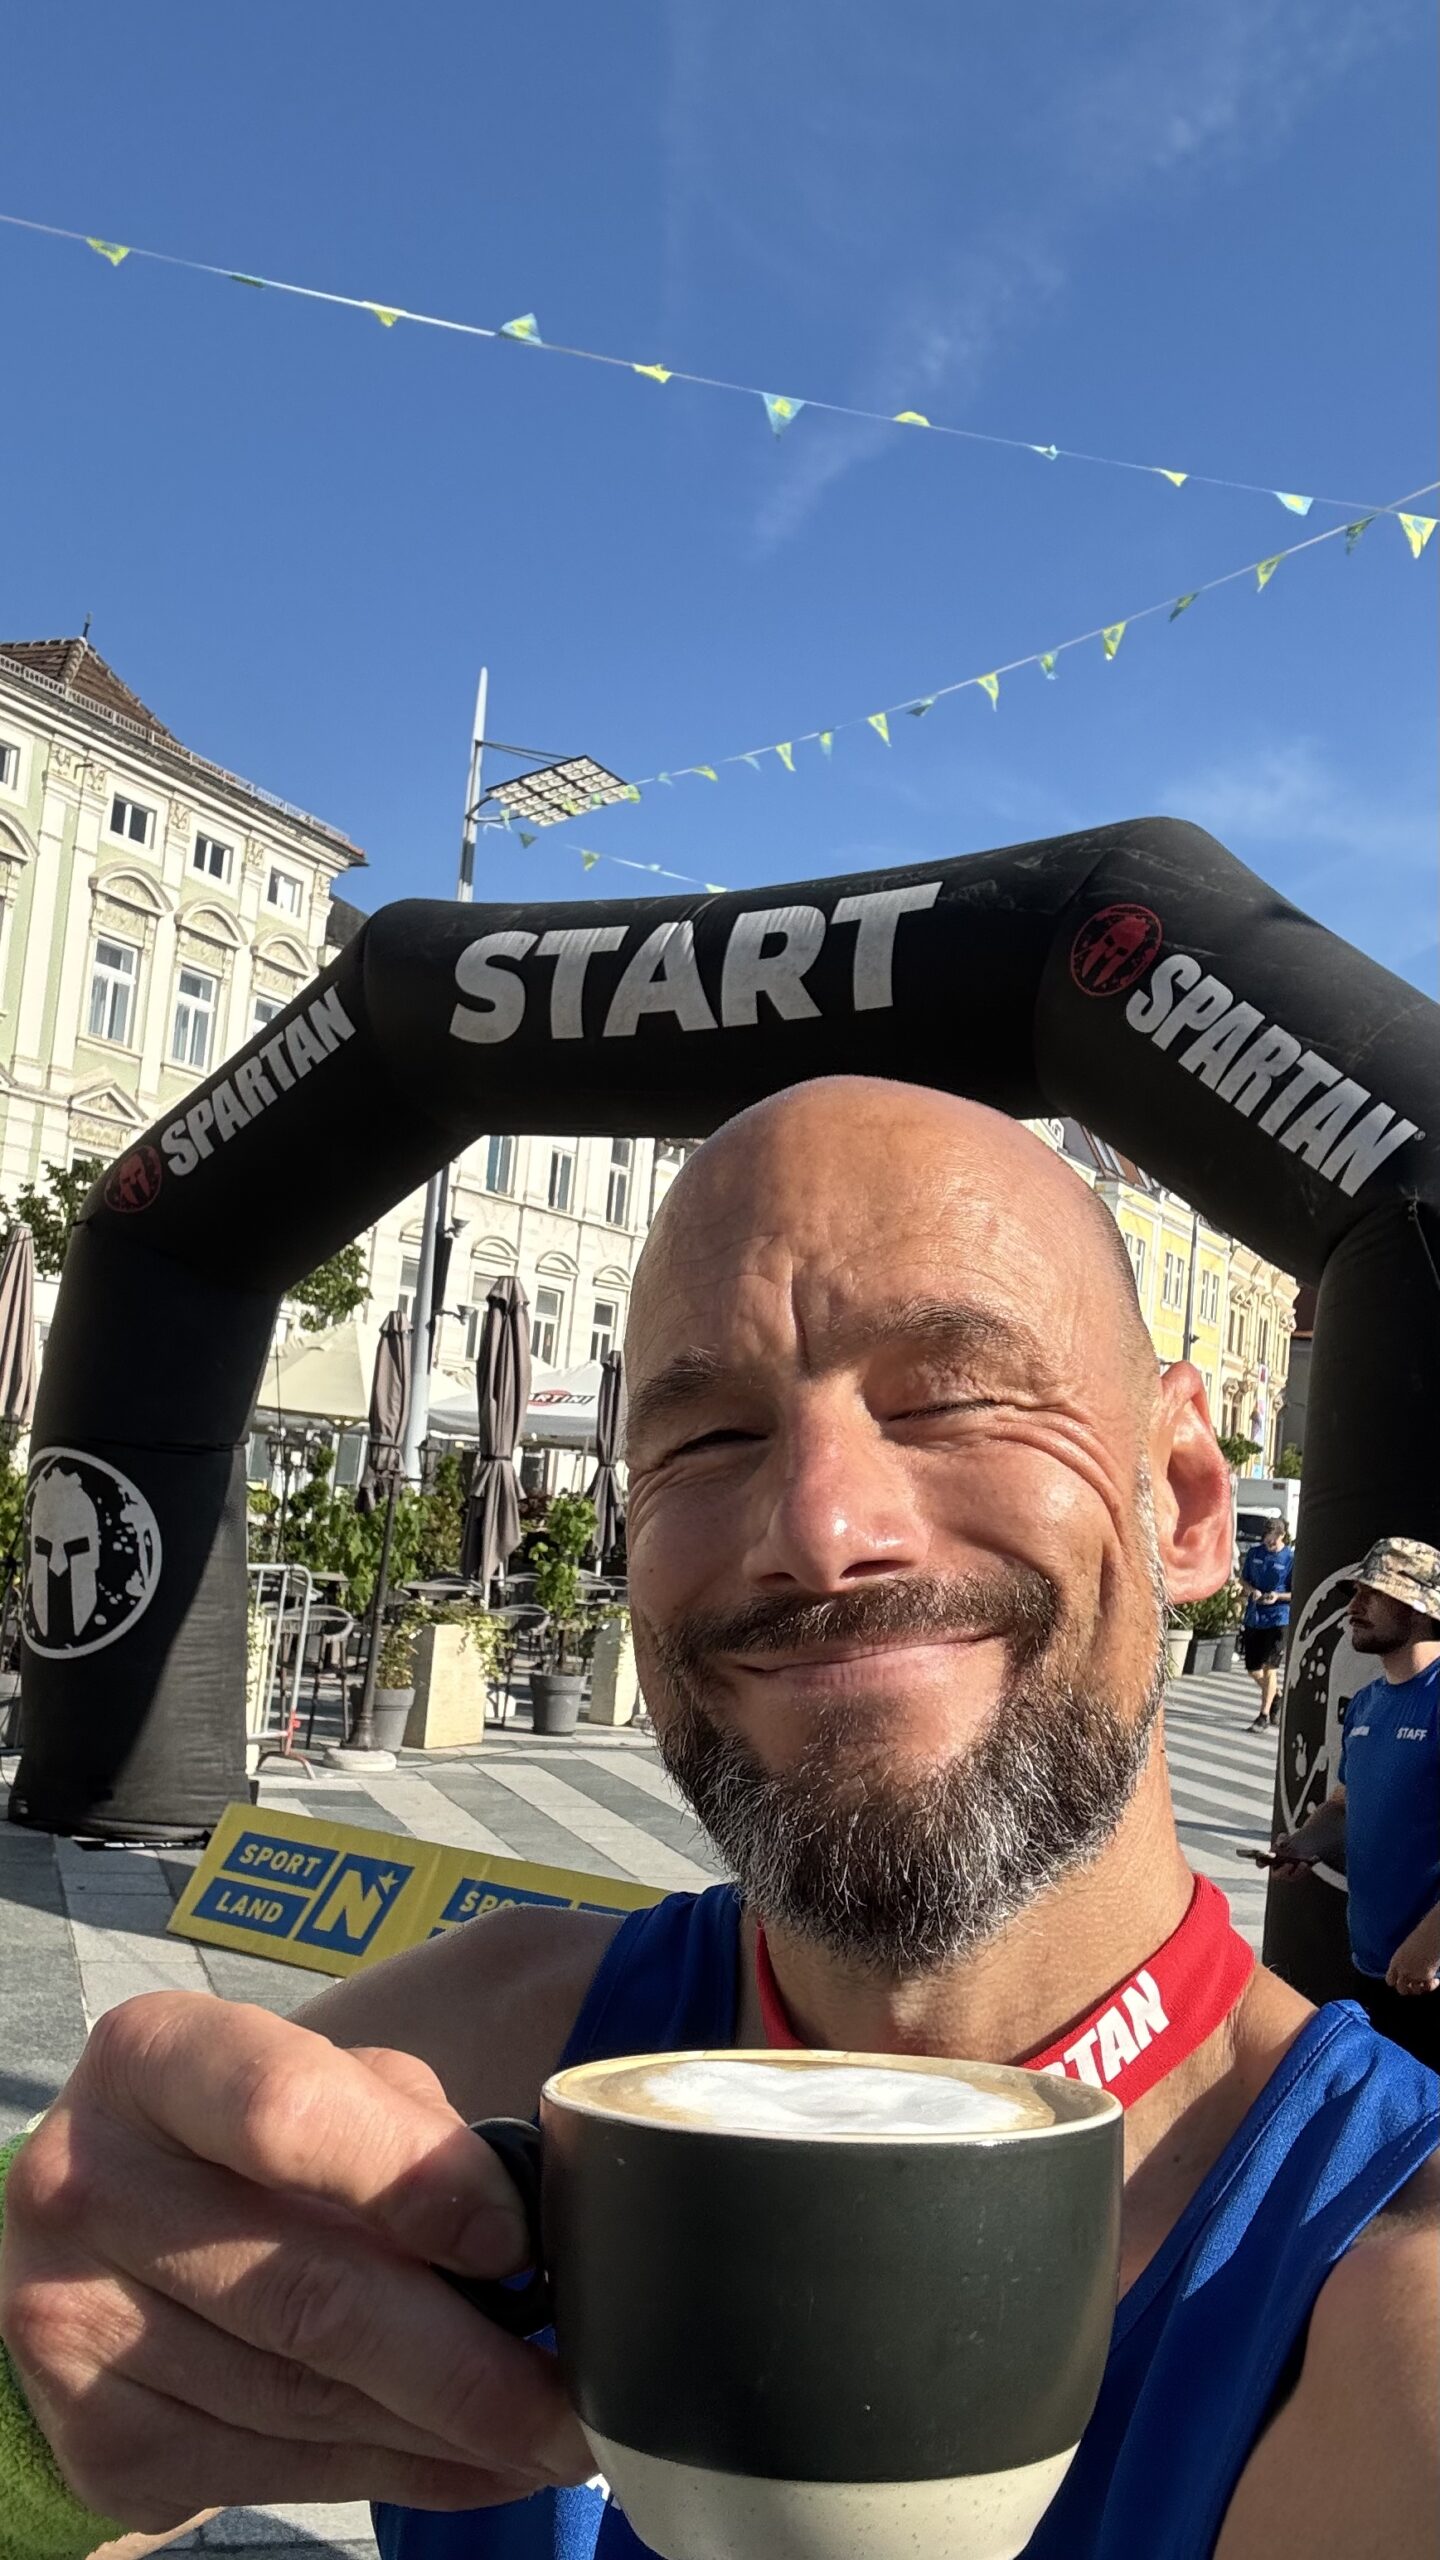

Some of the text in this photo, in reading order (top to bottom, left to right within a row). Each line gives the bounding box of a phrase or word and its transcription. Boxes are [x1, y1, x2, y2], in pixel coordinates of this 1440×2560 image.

[449, 881, 943, 1044] START
[161, 985, 357, 1176] SPARTAN
[1126, 953, 1419, 1198] SPARTAN
[1396, 1727, 1428, 1741] STAFF
[215, 1890, 284, 1923] LAND
[239, 1843, 322, 1877] SPORT
[1041, 1969, 1170, 2088] TAN
